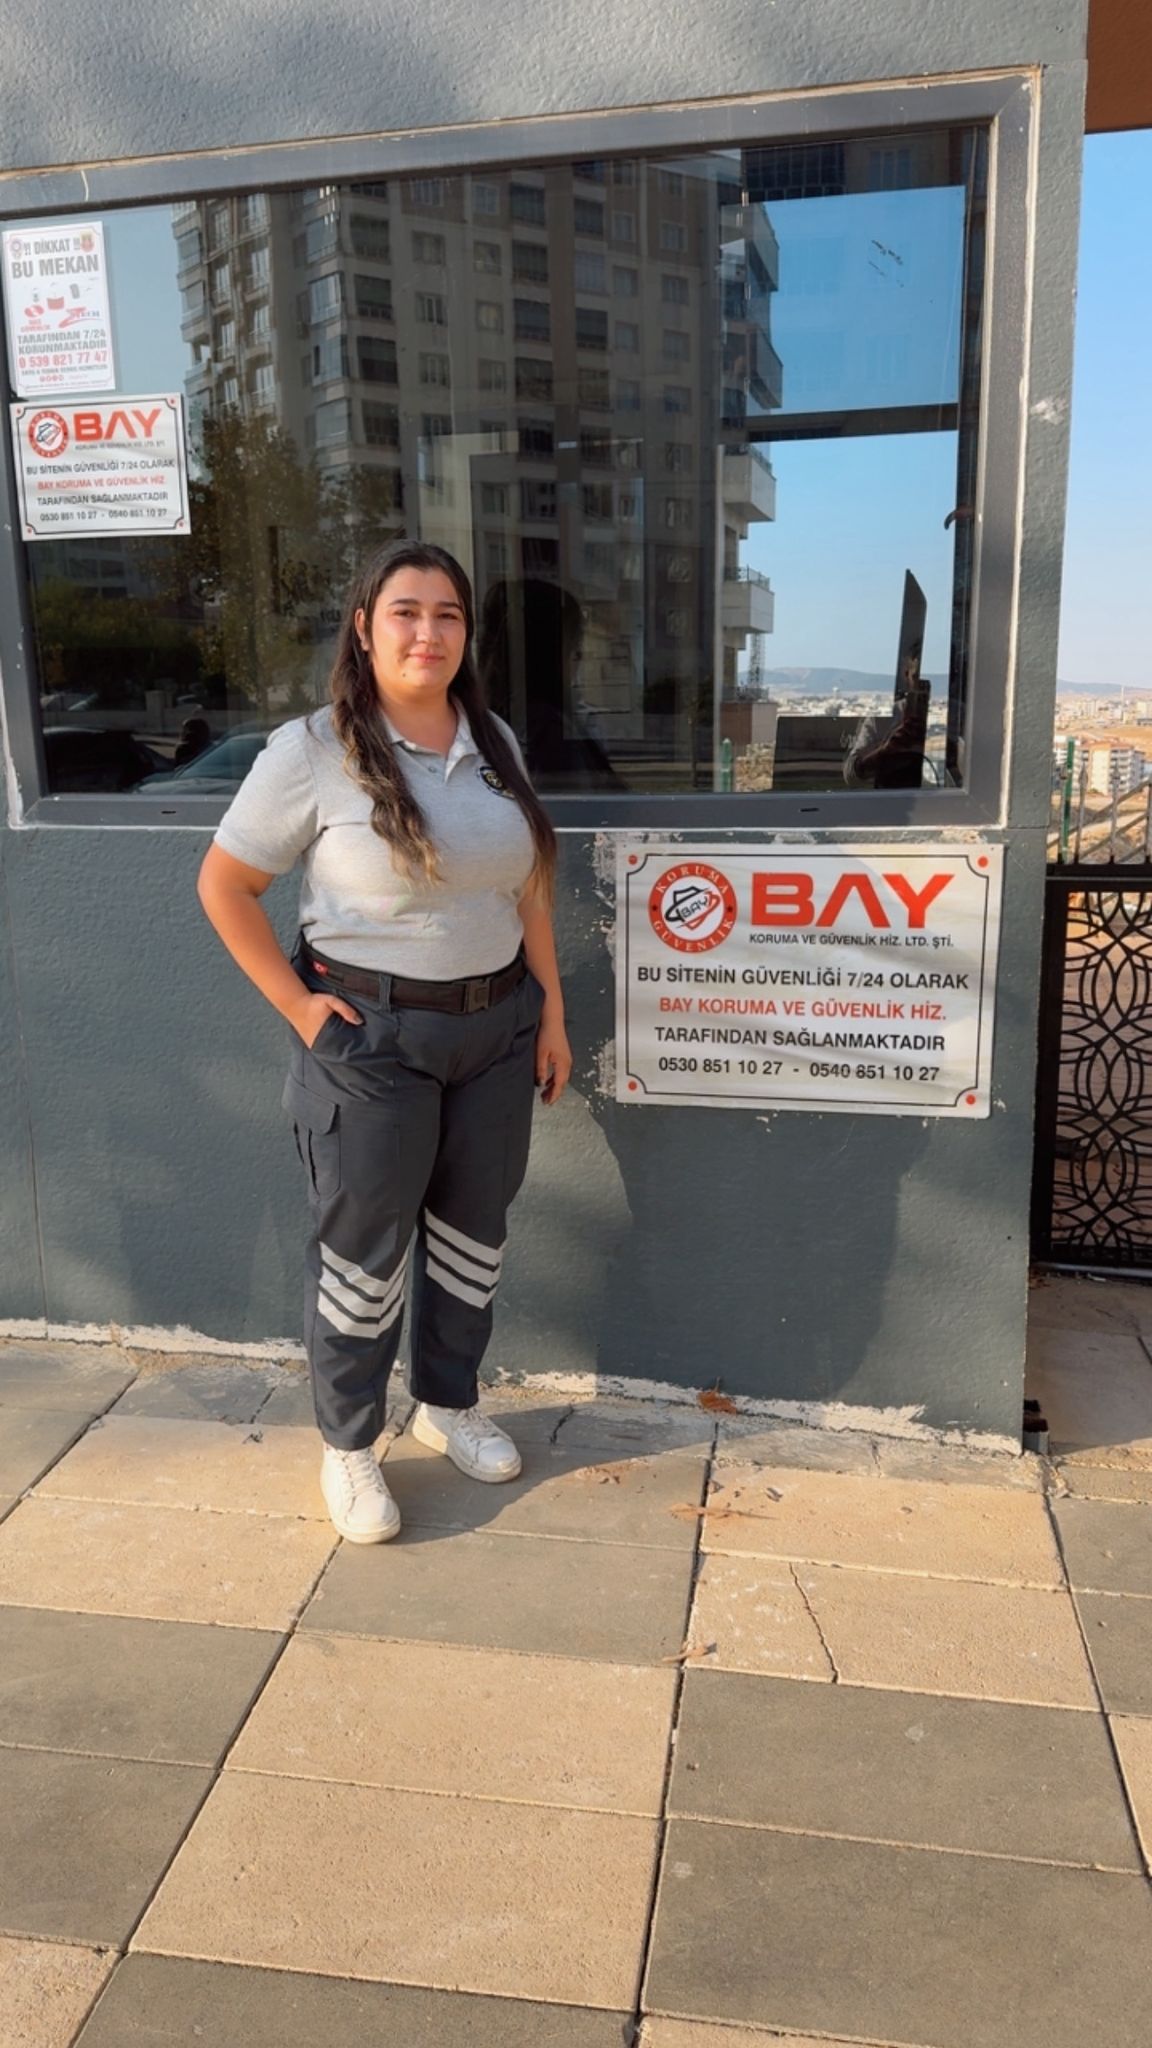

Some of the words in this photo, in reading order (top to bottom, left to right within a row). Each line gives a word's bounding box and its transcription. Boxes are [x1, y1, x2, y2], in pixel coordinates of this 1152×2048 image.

[11, 260, 34, 279] BU
[38, 254, 99, 276] MEKAN
[17, 330, 81, 345] TARAFINDAN
[83, 329, 106, 340] 7/24
[18, 340, 107, 355] KORUNMAKTADIR
[73, 408, 161, 442] BAY
[27, 466, 38, 475] BU
[139, 459, 175, 470] OLARAK
[37, 480, 54, 491] BAY
[55, 479, 92, 490] KORUMA
[94, 478, 104, 488] VE
[37, 495, 89, 505] TARAFINDAN
[655, 865, 729, 894] KORUMA
[751, 872, 955, 929] BAY
[749, 933, 798, 945] KORUMA
[801, 934, 816, 945] VE
[819, 932, 877, 947] GÜVENLİK
[905, 936, 929, 948] LTD.
[637, 966, 661, 982] BU
[666, 964, 736, 984] SİTENİN
[742, 966, 841, 986] GÜVENLİĞİ
[847, 971, 884, 988] 7/24
[890, 973, 969, 990] OLARAK
[659, 997, 693, 1013] BAY
[698, 998, 777, 1016] KORUMA
[783, 1000, 805, 1016] VE
[811, 998, 905, 1020] GÜVENLİK
[911, 1001, 946, 1021] HİZ.
[655, 1026, 767, 1046] TARAFINDAN
[773, 1027, 946, 1051] SAĞLANMAKTADIR
[659, 1056, 697, 1072] 0530
[703, 1058, 730, 1074] 851
[738, 1060, 757, 1075] 10
[762, 1060, 783, 1075] 27
[809, 1062, 850, 1078] 0540
[856, 1065, 885, 1079] 851
[894, 1065, 913, 1081] 10
[918, 1066, 940, 1081] 27
